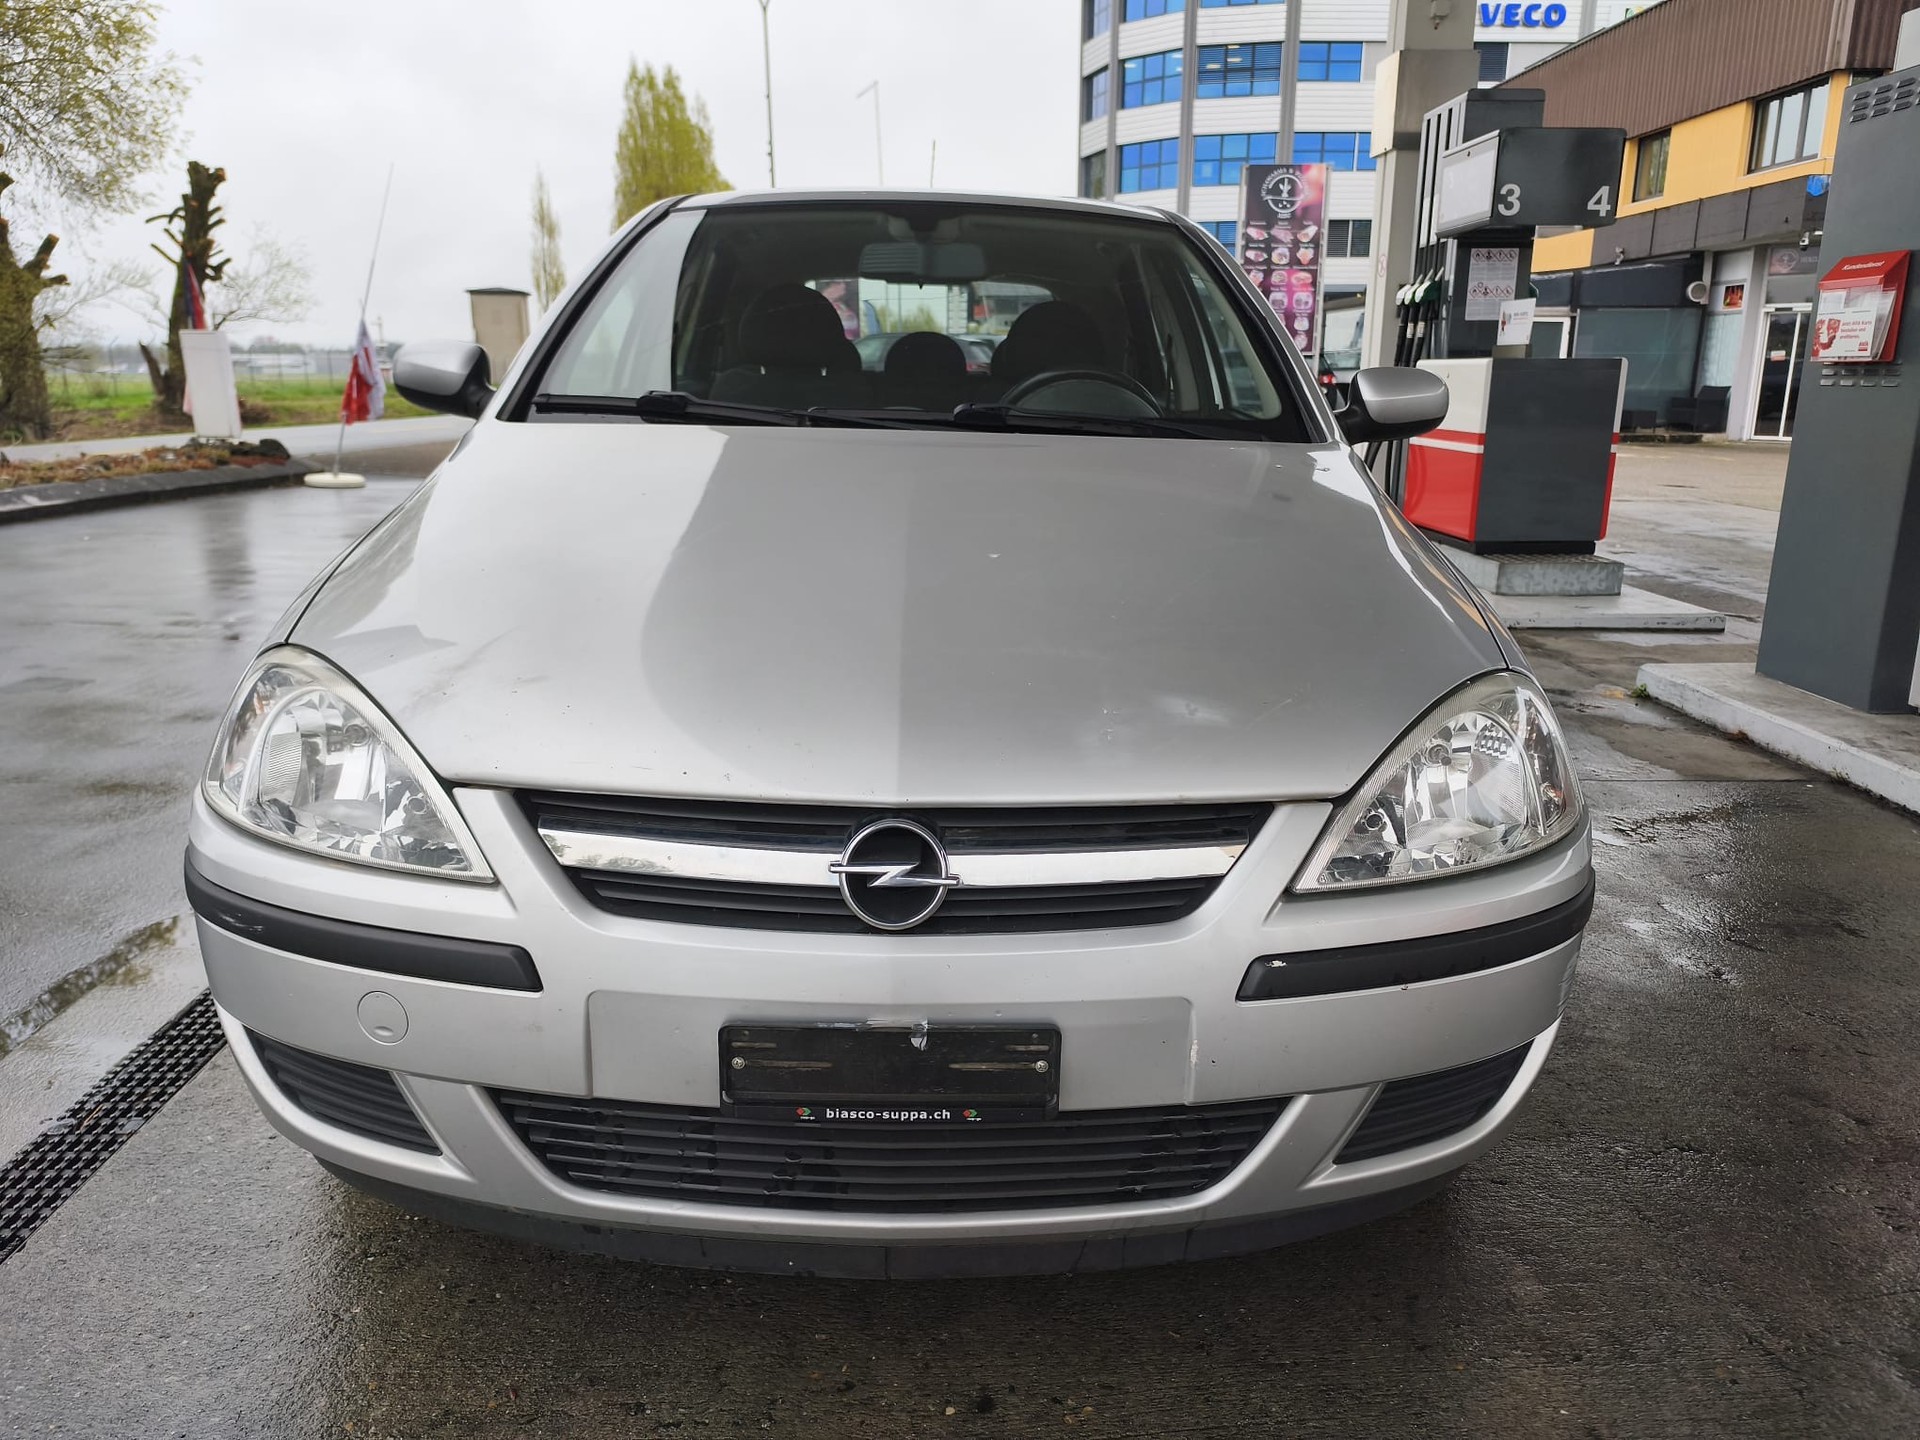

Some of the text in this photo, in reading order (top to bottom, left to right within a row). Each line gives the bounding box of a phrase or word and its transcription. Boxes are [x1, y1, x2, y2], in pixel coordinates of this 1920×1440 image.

[1497, 183, 1521, 217] 3
[1586, 185, 1611, 217] 4
[826, 1108, 951, 1122] biasco-suppa.ch
